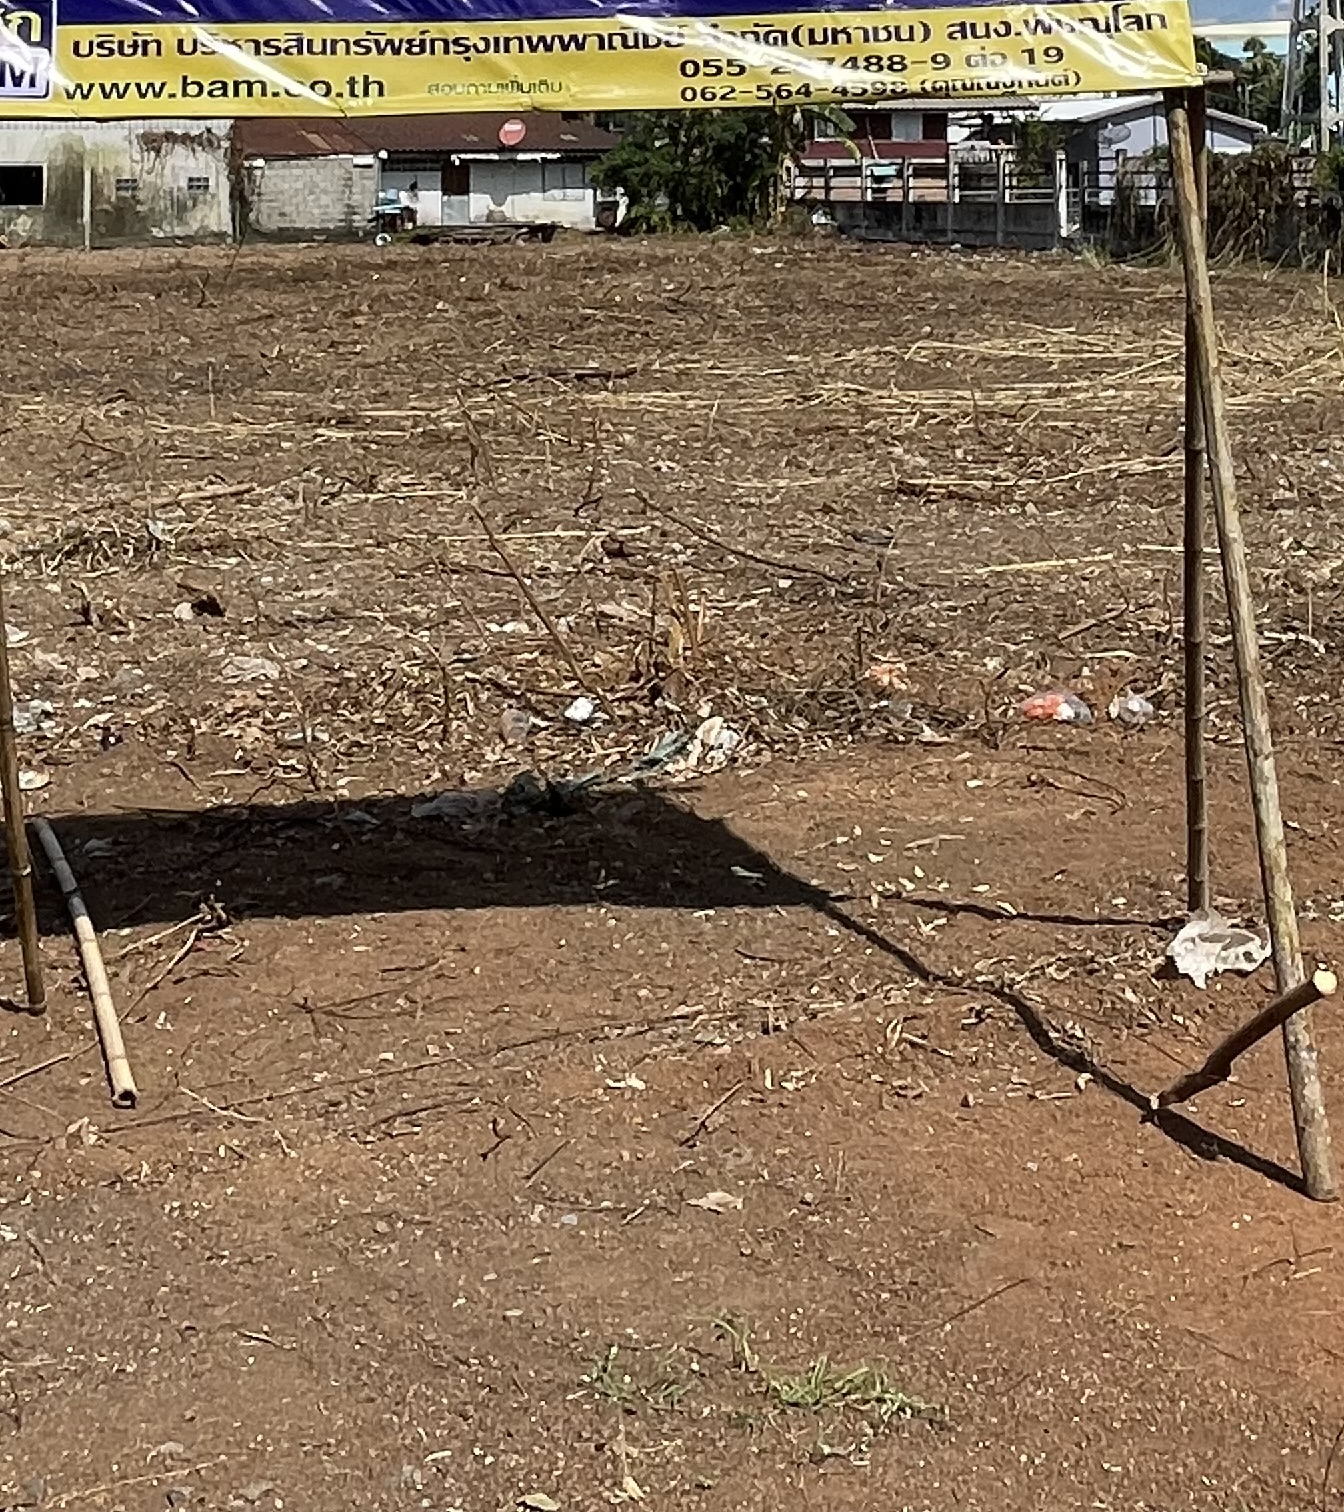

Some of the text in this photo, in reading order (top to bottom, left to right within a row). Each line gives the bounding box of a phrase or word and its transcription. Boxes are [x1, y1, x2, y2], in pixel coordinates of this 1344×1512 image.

[73, 30, 162, 59] บริษัท
[1021, 45, 1065, 66] 19
[63, 74, 386, 102] www.bam.co.th
